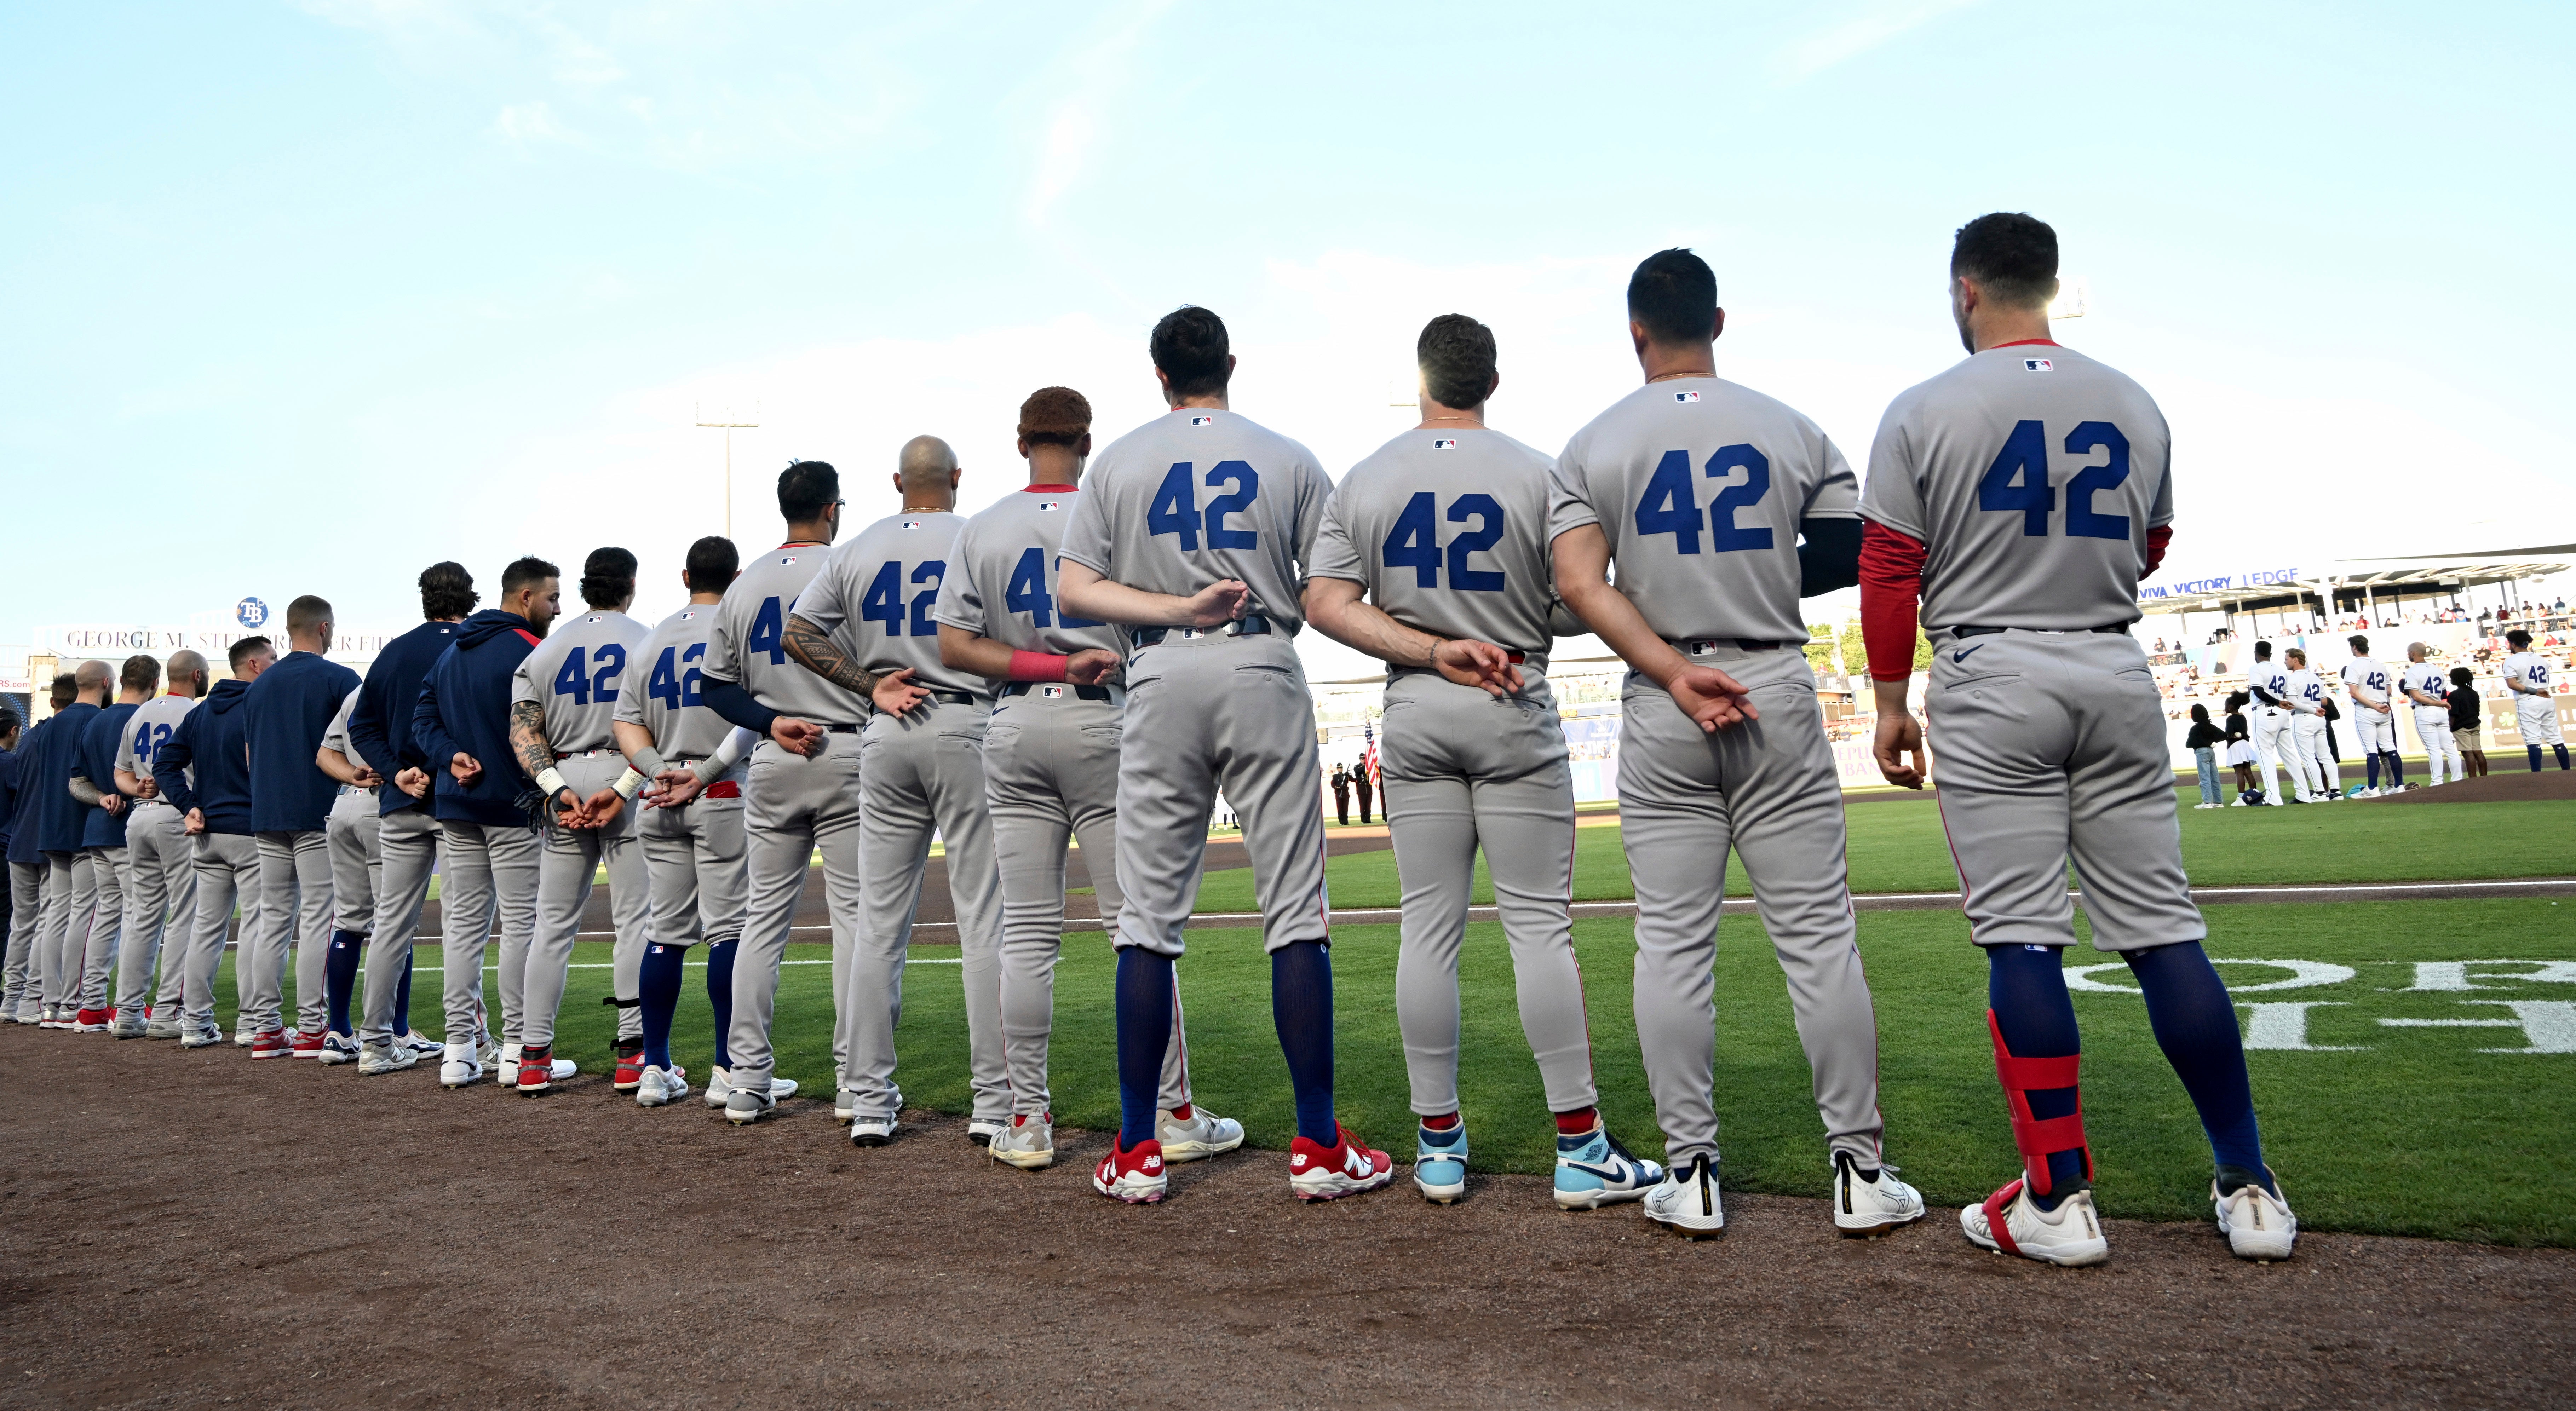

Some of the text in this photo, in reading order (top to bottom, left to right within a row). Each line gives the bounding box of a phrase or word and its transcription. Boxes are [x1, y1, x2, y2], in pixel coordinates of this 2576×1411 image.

[1979, 420, 2130, 540] 42
[1147, 461, 1258, 551] 42
[1635, 444, 1773, 554] 42
[1383, 492, 1503, 591] 42
[2139, 587, 2168, 598] VIVA
[2174, 576, 2231, 594] VICTORY
[862, 560, 946, 636] 42
[241, 602, 263, 623] TB
[68, 630, 157, 649] GEORGE
[555, 643, 626, 705] 42
[649, 643, 706, 709] 42
[2269, 675, 2285, 694] 42
[2367, 672, 2385, 690] 42
[2529, 666, 2546, 683] 42
[2304, 684, 2321, 701] 42
[2424, 676, 2442, 694] 42
[1142, 1155, 1161, 1169] NB
